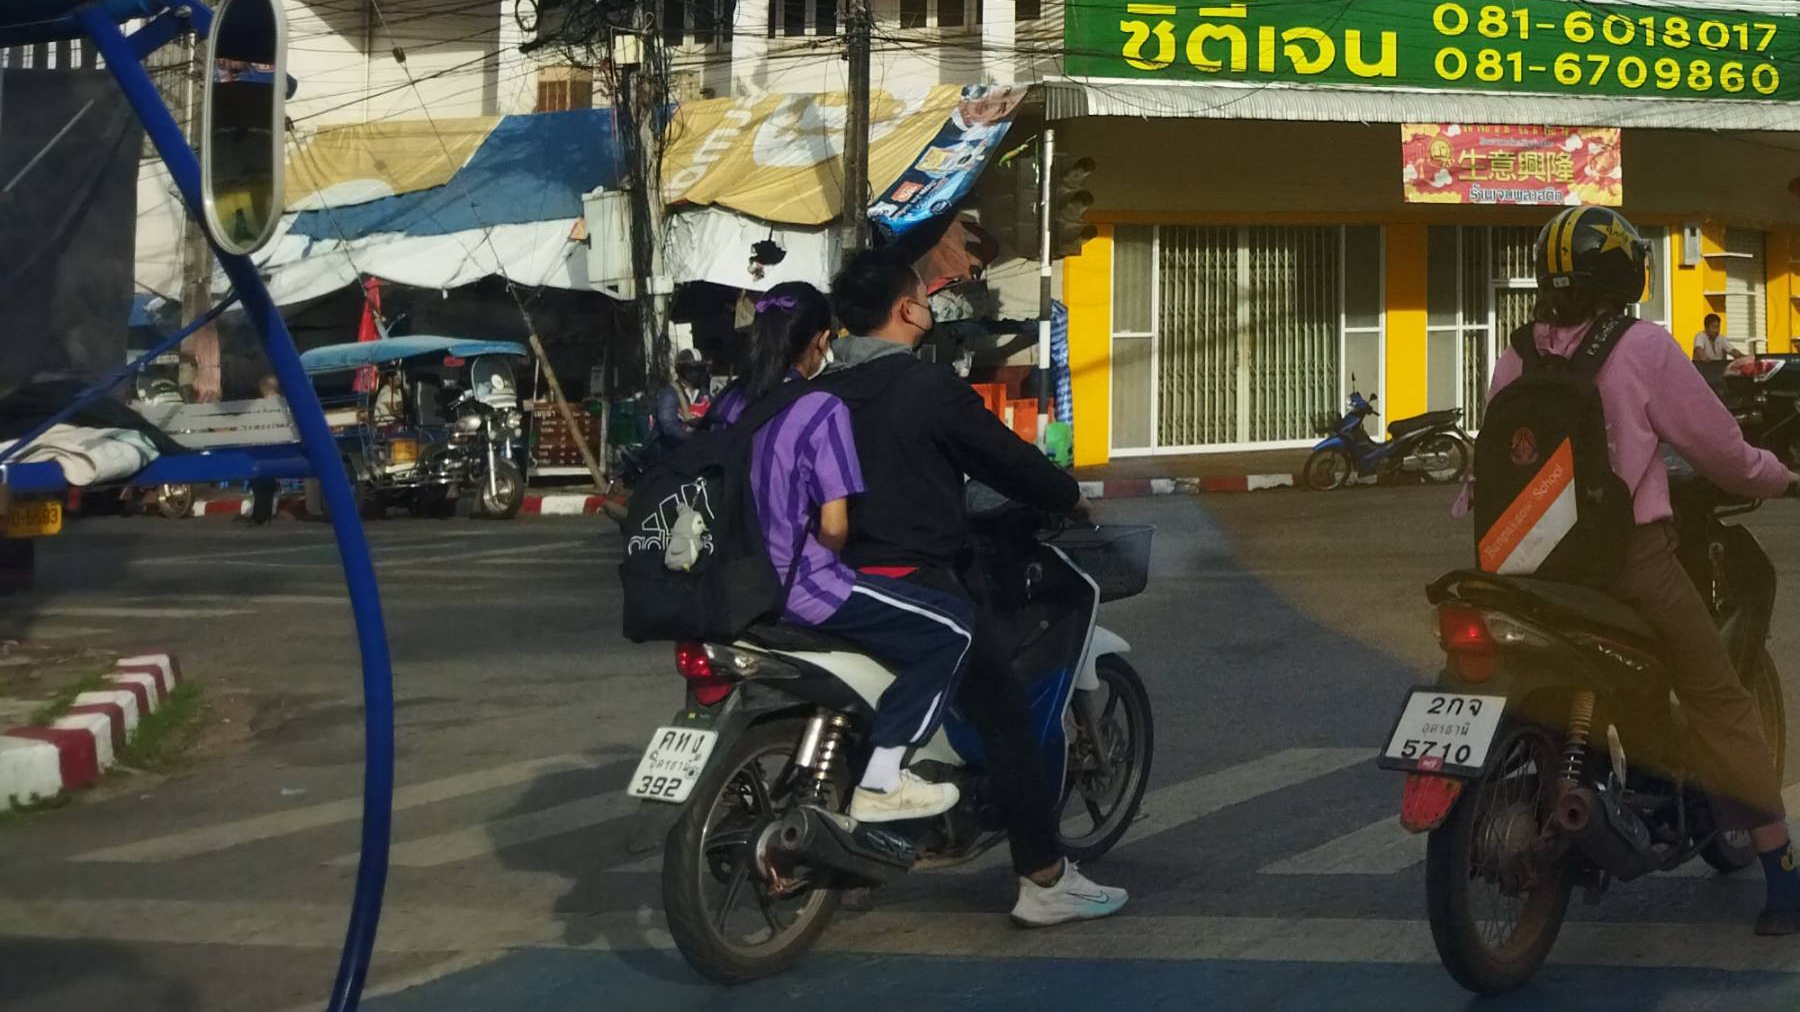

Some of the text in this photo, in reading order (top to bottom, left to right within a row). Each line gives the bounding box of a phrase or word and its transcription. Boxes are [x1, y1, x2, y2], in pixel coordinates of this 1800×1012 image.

[1432, 1, 1778, 52] 081-6018017
[1434, 45, 1780, 94] 081-6709860
[1457, 148, 1575, 184] 生意興隆
[1427, 696, 1483, 716] 2กจ
[1401, 739, 1471, 763] 5710
[636, 775, 682, 798] 392
